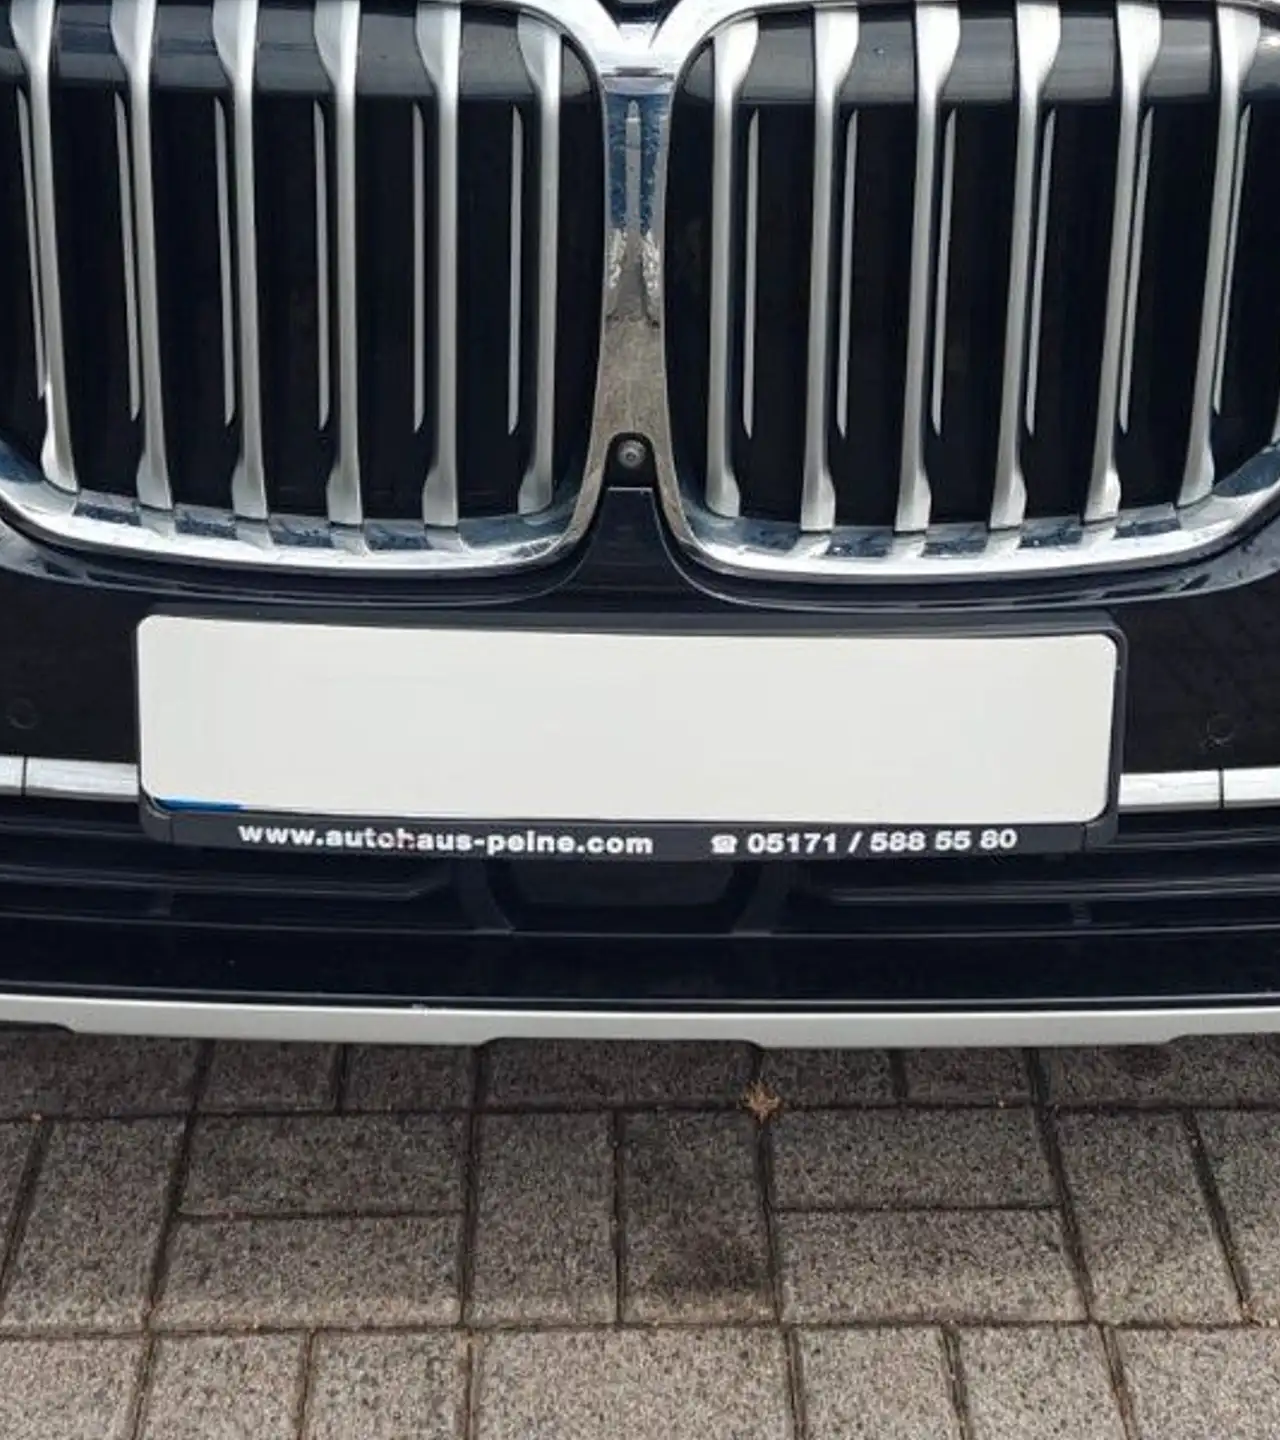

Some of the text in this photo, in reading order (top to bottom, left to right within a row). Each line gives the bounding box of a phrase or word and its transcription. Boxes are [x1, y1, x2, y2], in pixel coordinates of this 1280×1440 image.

[238, 822, 653, 855] www.autohaus-peine.com
[748, 831, 836, 853] 05171
[870, 831, 925, 851] 588
[934, 830, 970, 850] 55
[980, 828, 1017, 850] 80
